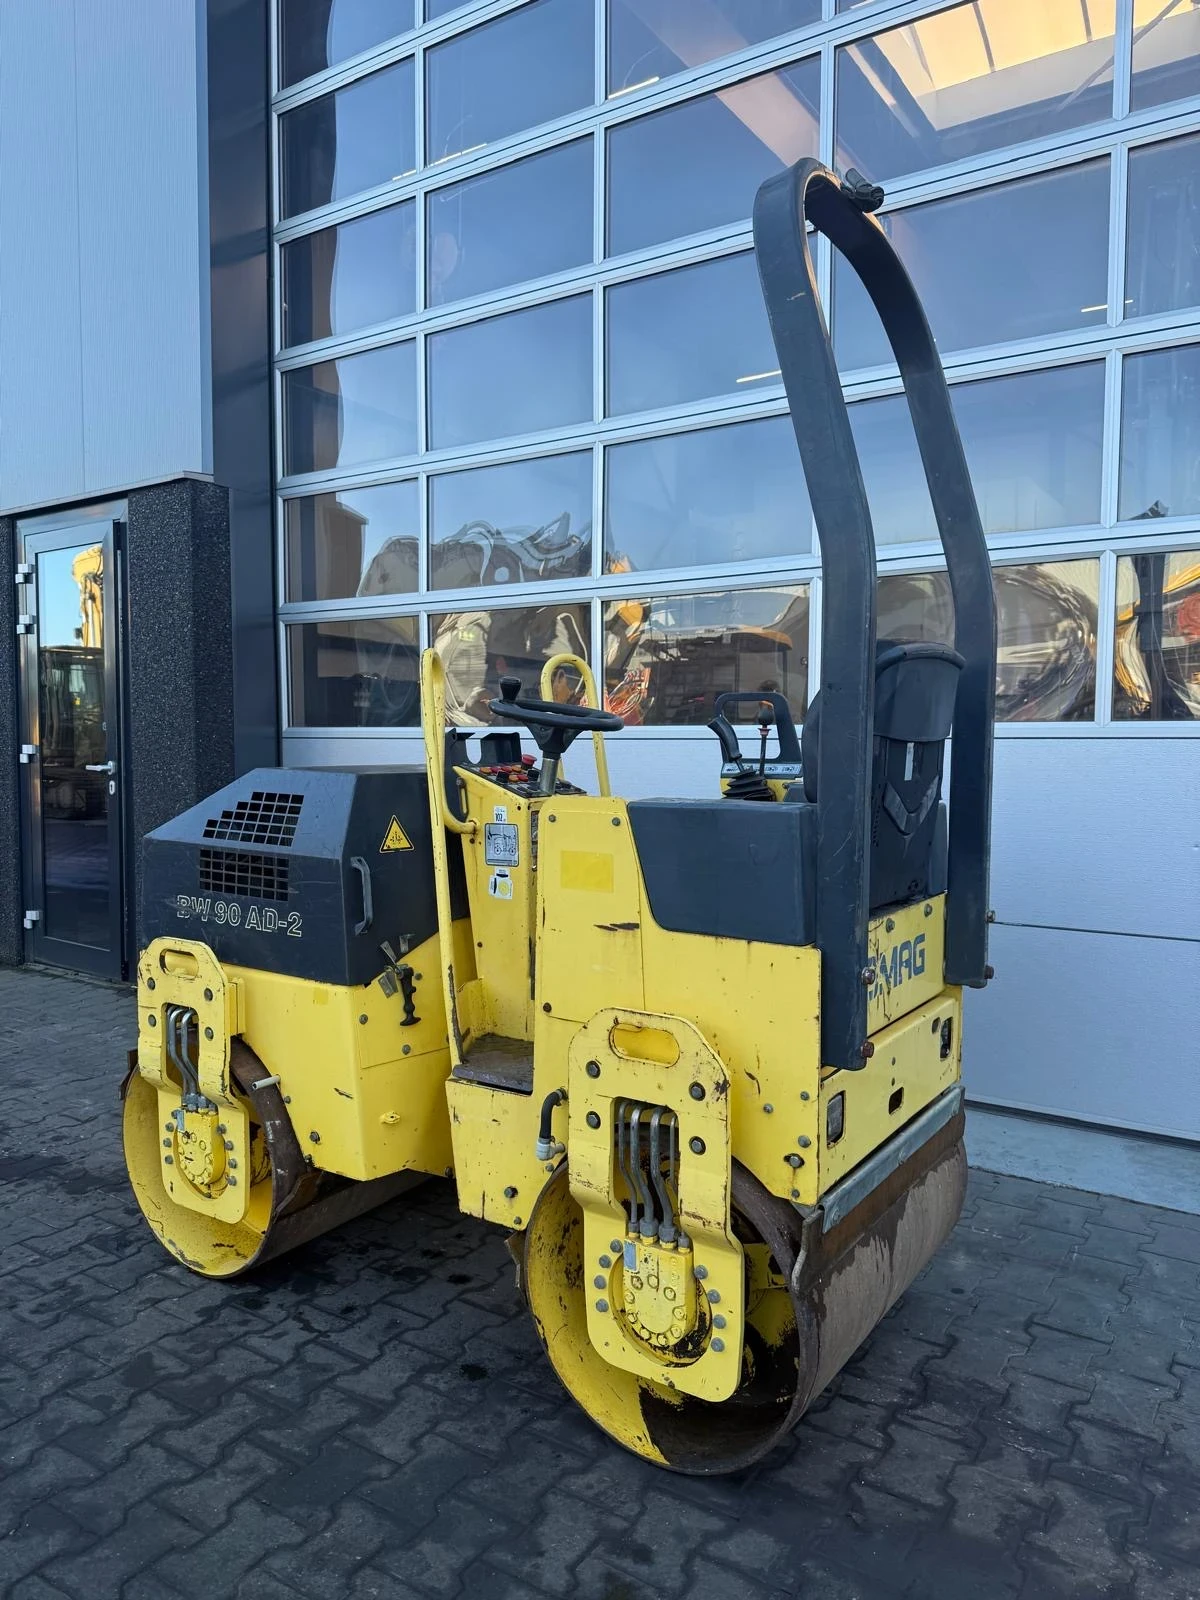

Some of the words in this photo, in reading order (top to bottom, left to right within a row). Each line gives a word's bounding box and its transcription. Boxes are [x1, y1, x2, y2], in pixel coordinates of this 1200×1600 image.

[177, 895, 211, 922] BW
[214, 900, 241, 926] 90
[245, 905, 303, 937] AD-2
[868, 933, 926, 1001] MAG
